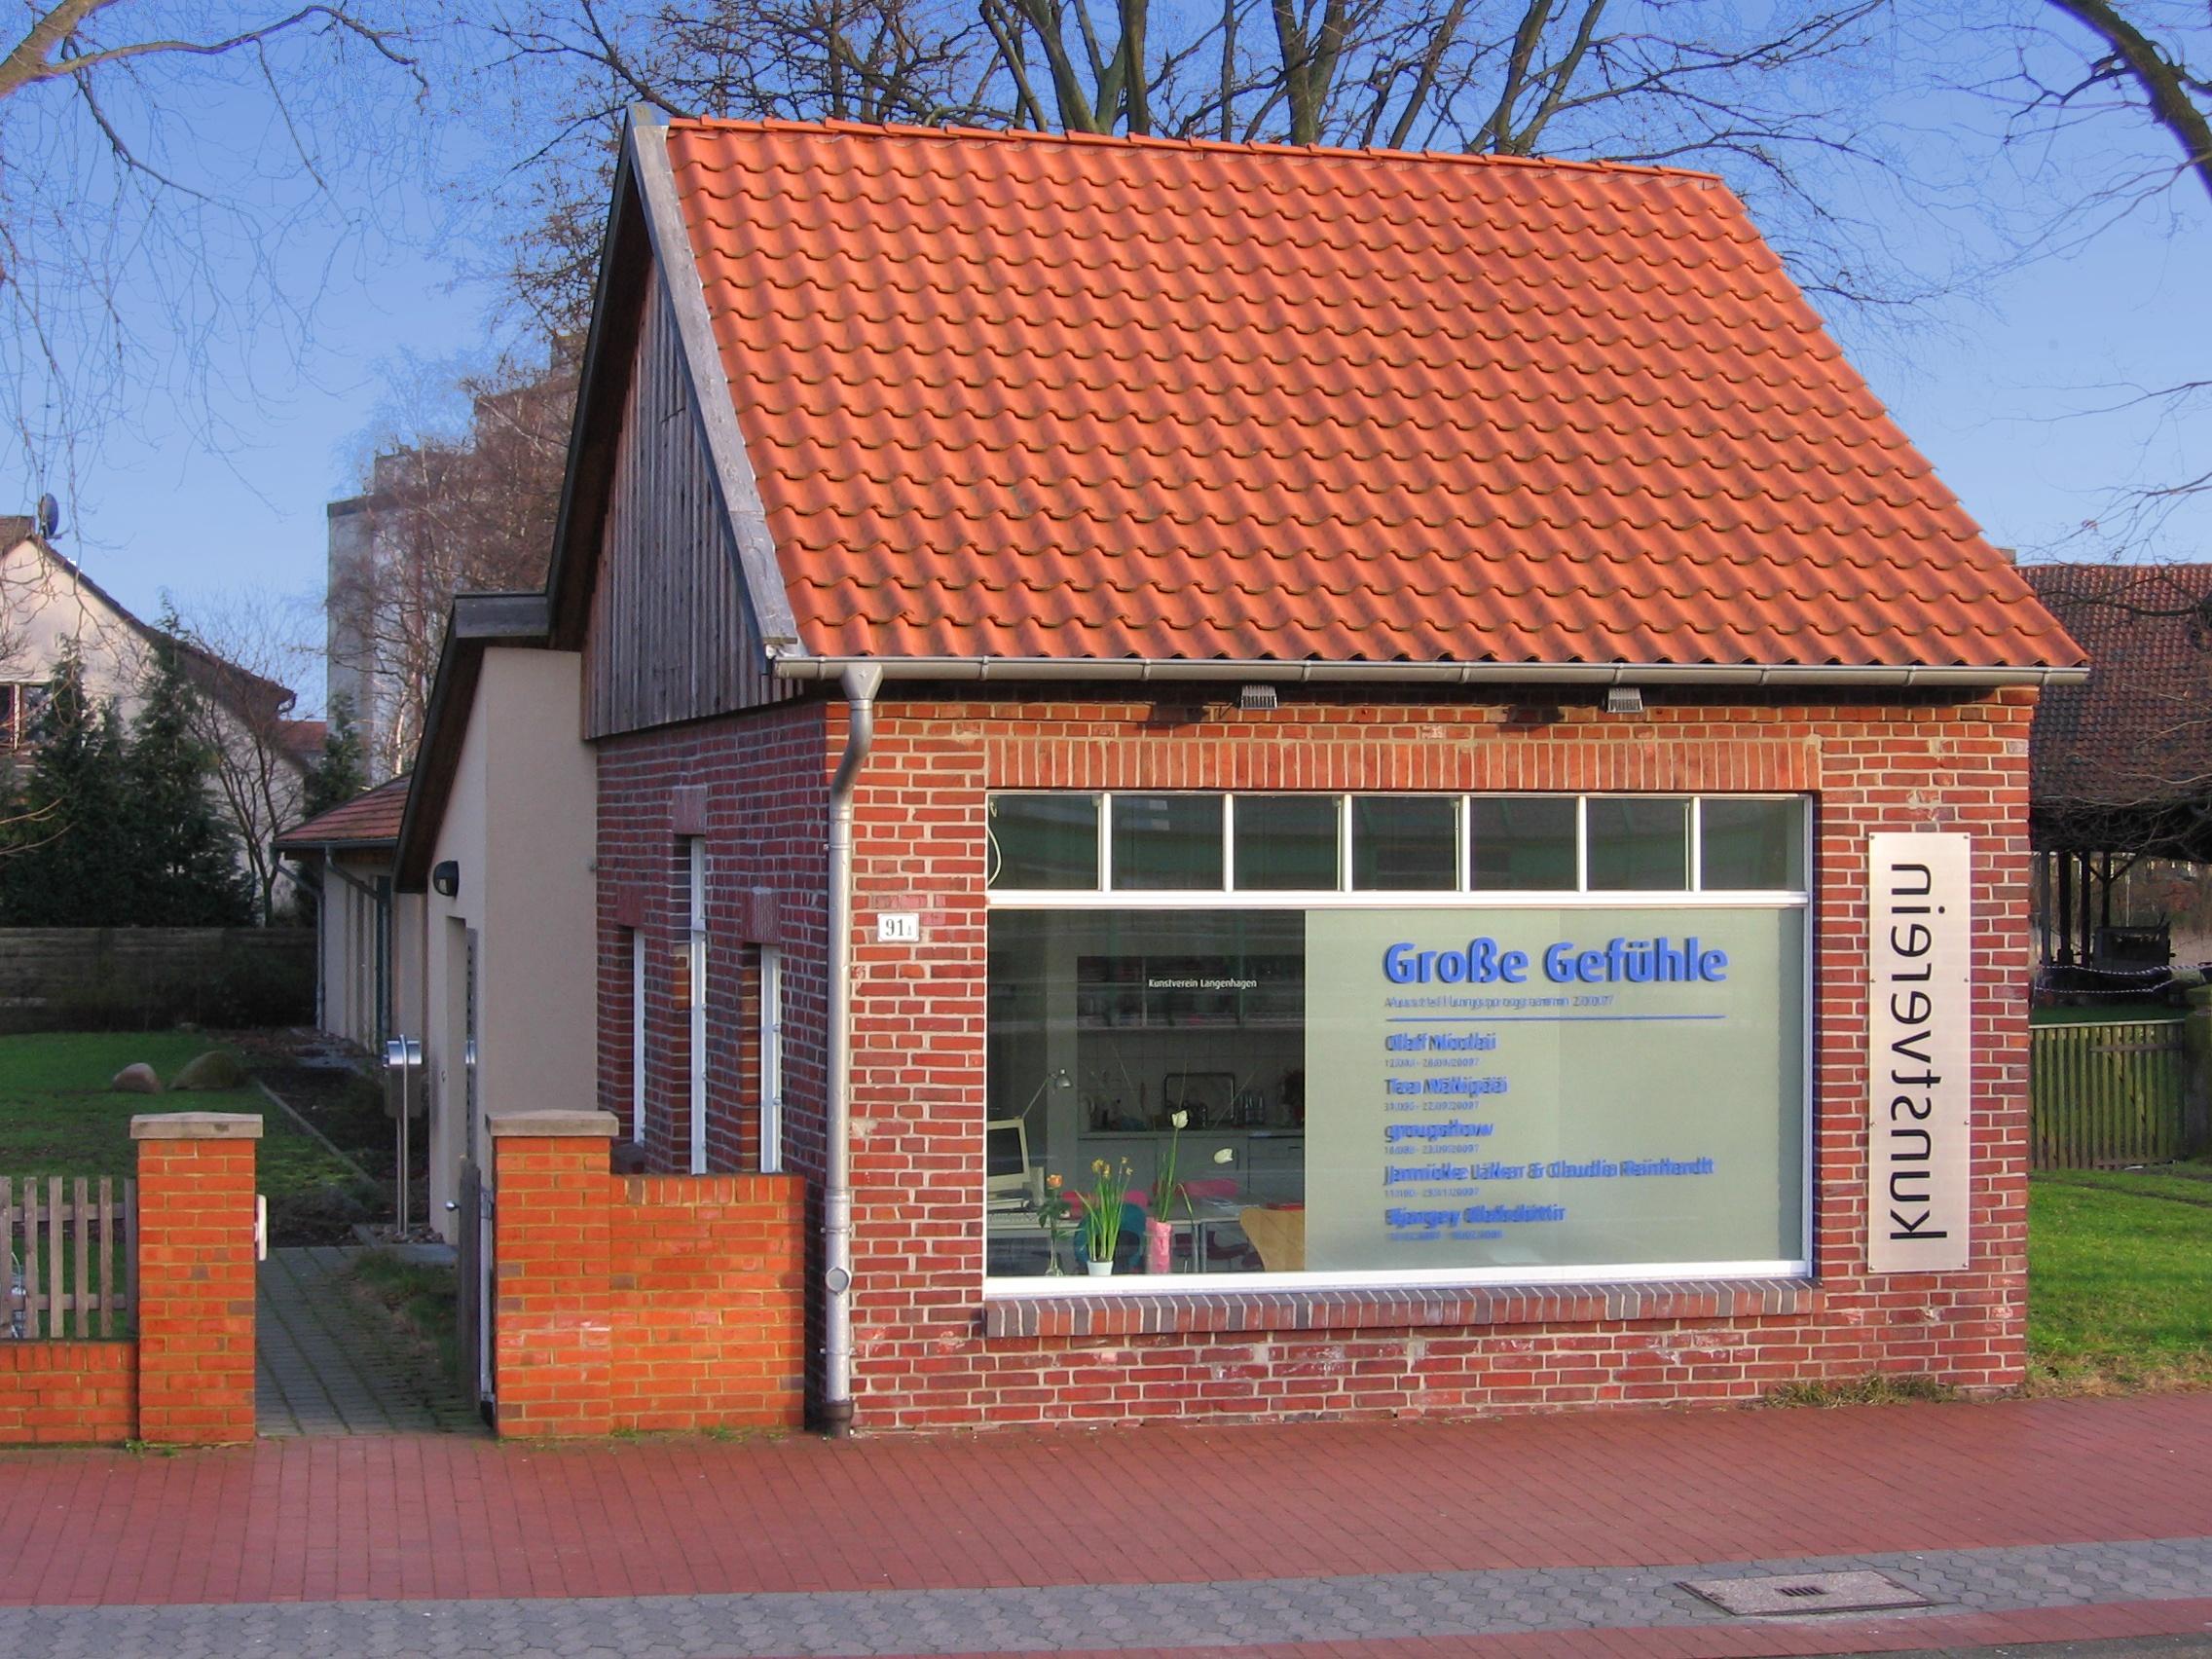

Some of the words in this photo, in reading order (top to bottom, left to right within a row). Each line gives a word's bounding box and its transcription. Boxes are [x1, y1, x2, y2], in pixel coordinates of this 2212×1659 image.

[885, 918, 904, 937] 91
[1383, 937, 1530, 984] Große
[1545, 937, 1729, 983] Gefühle
[1148, 977, 1198, 988] Kunstverein
[1199, 977, 1258, 990] Langenhagen
